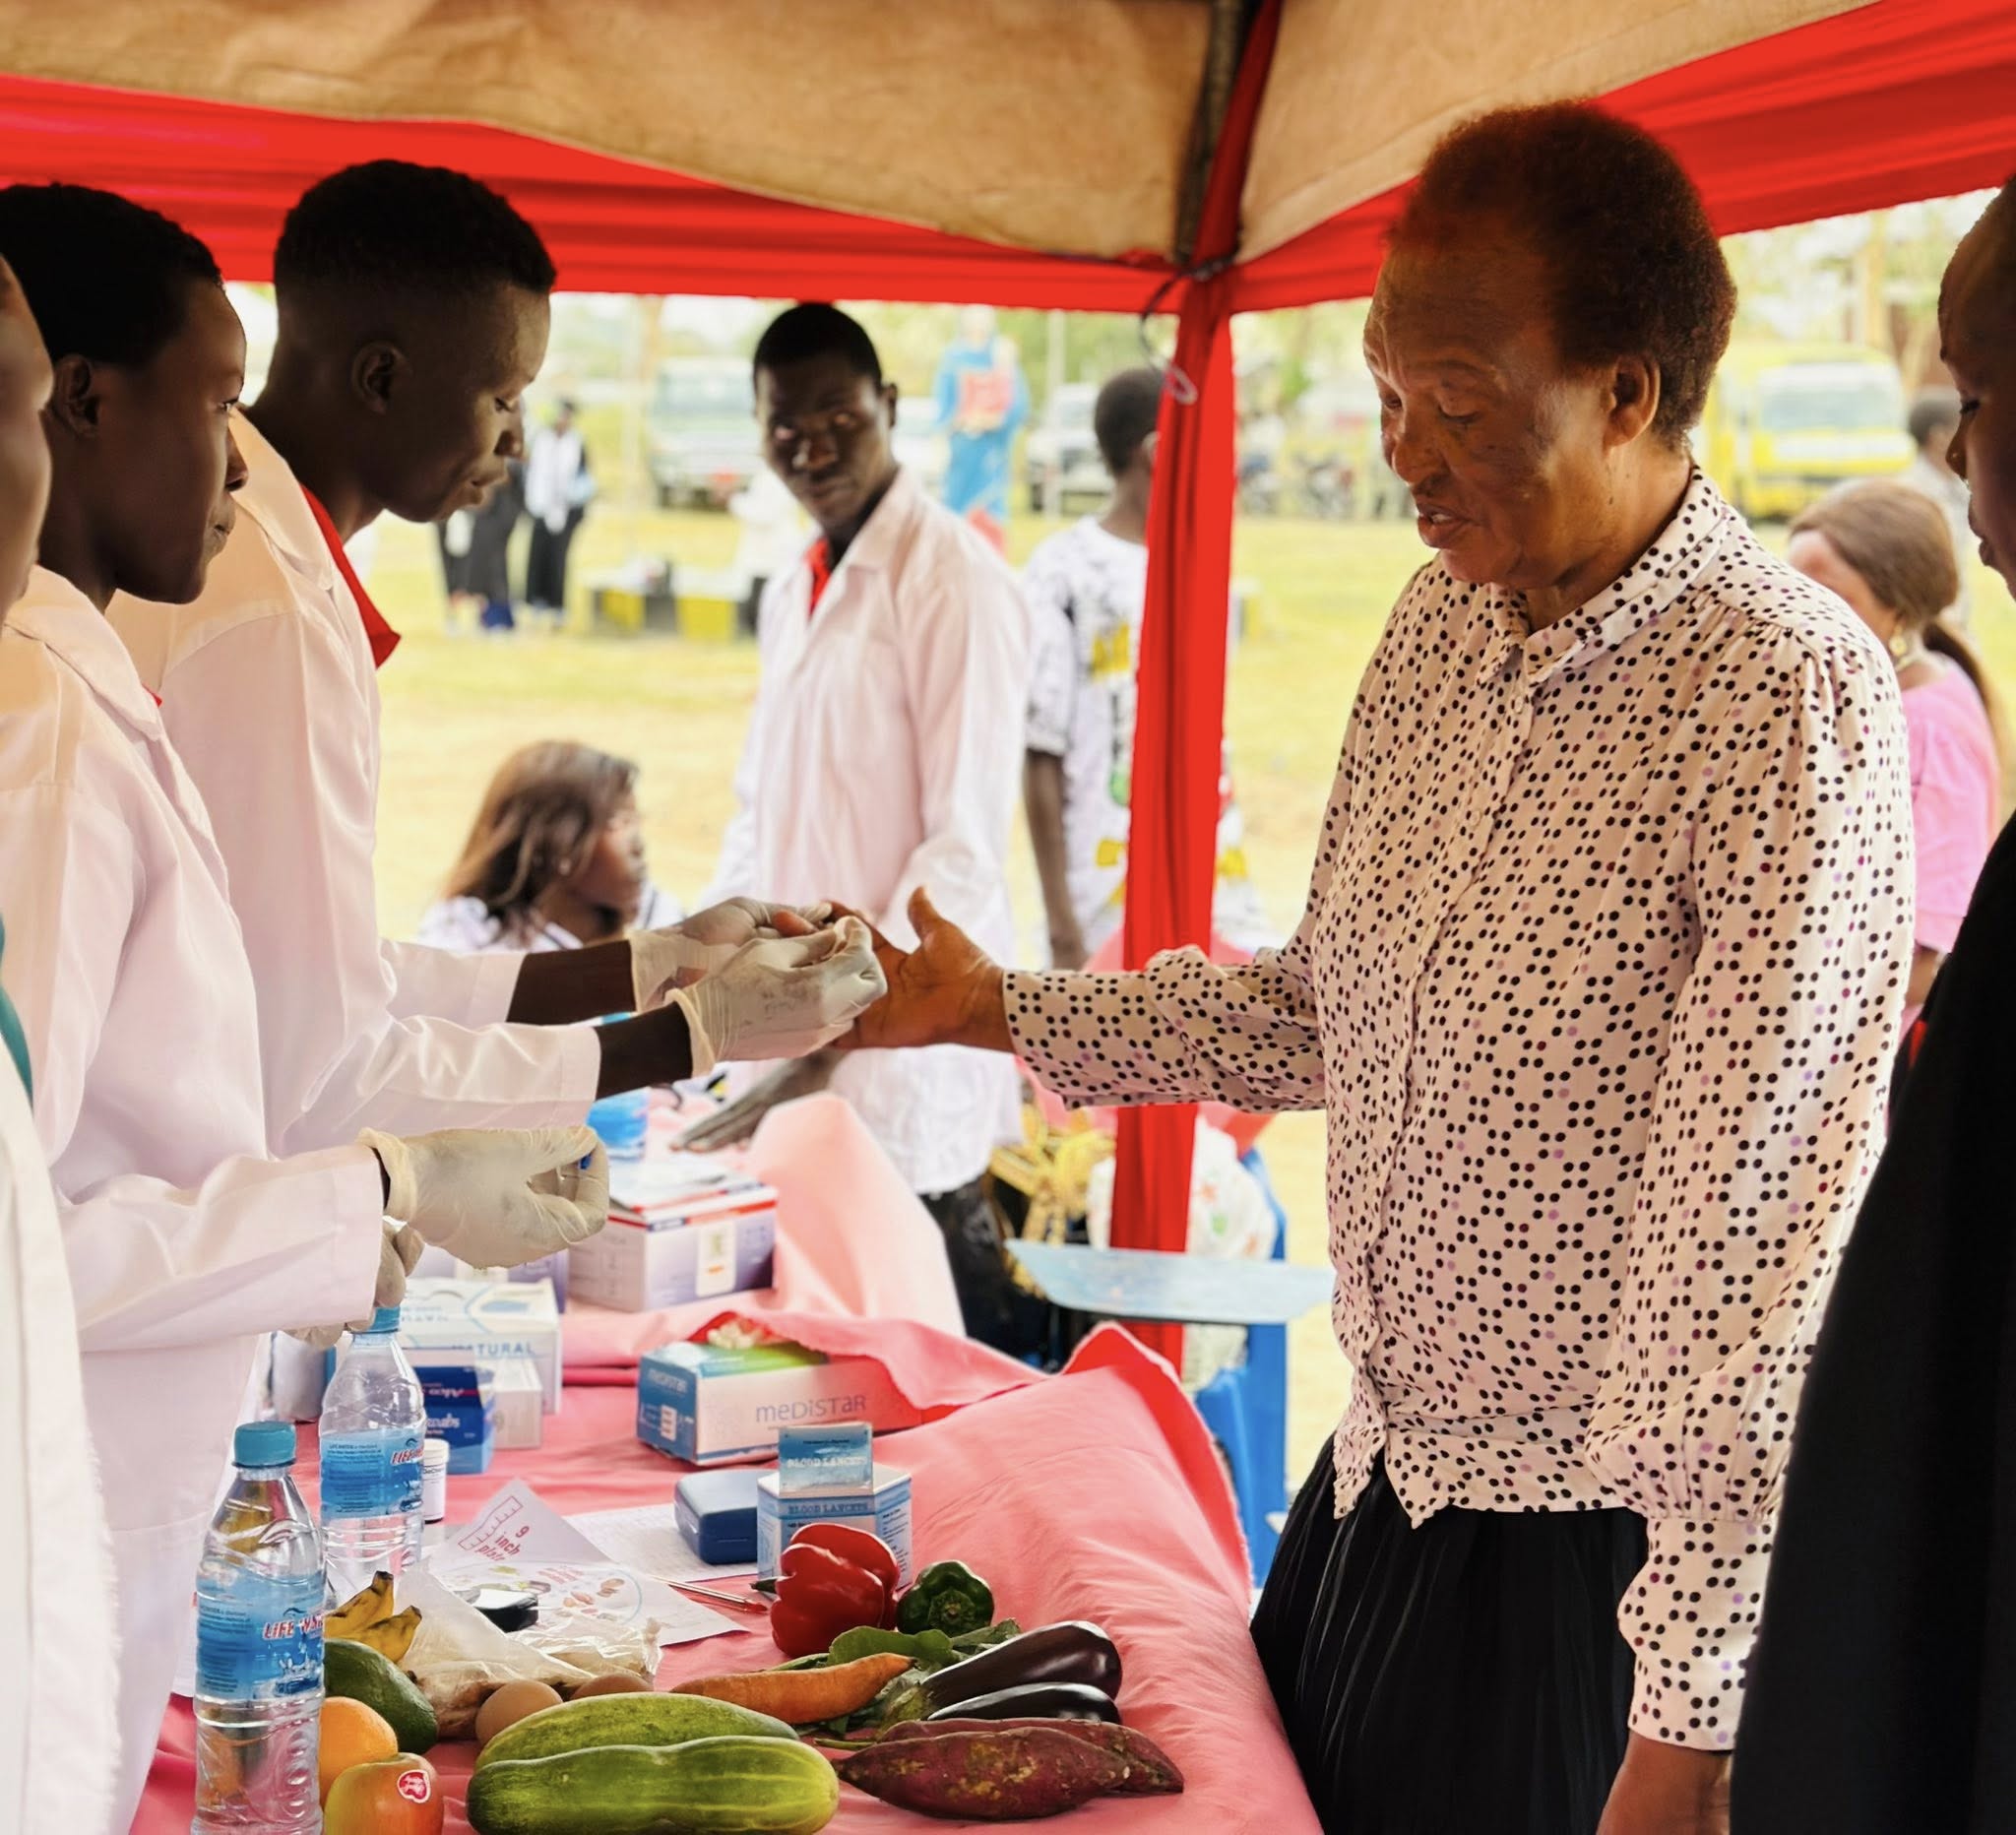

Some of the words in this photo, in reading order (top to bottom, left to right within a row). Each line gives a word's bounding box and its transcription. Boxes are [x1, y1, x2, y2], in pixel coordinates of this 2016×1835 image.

[788, 1458, 821, 1468] BLOOD
[788, 1504, 821, 1514] BLOOD
[515, 1525, 531, 1539] 9
[494, 1531, 521, 1555] inch
[263, 1620, 295, 1641] LIFE
